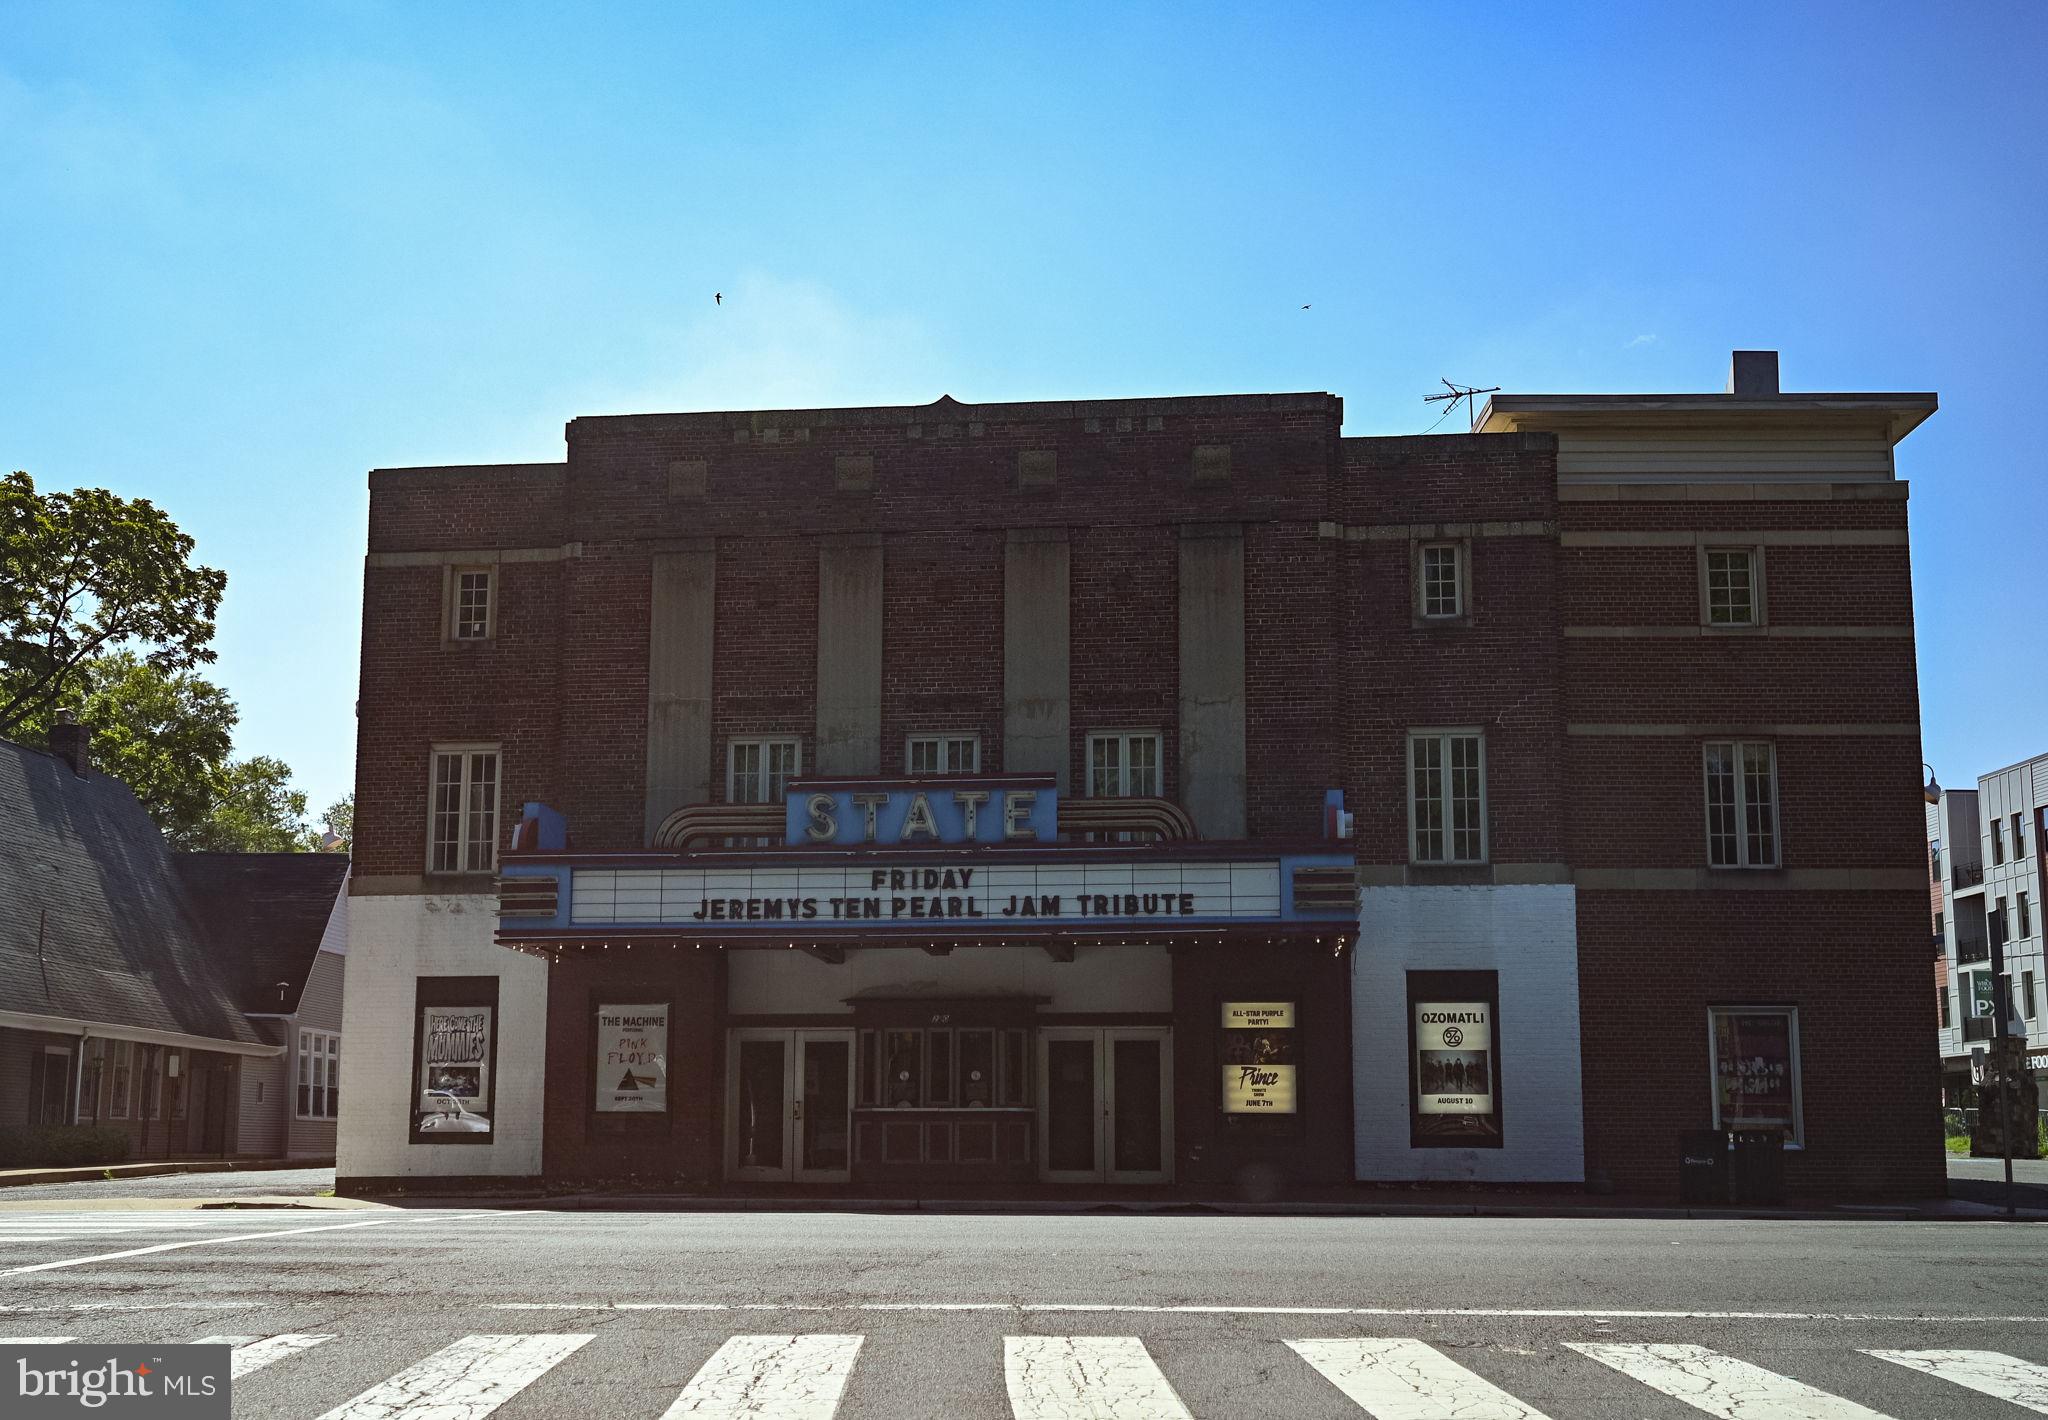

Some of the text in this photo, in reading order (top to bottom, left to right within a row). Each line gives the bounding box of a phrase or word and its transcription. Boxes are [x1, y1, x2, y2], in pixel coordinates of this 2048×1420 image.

[805, 791, 1038, 841] STATE
[872, 868, 974, 890] FRIDAY
[693, 893, 1194, 920] JEREMYS TEN PEARL JAM TRIBUTE
[430, 1014, 450, 1034] HERE
[468, 1014, 484, 1033] THE
[602, 1016, 665, 1026] THE MACHINE
[1421, 1012, 1485, 1024] OZOMATLI
[427, 1031, 485, 1064] MUMMIES
[619, 1038, 648, 1050] PINK
[608, 1051, 657, 1065] FLOYD
[2031, 1055, 2048, 1069] FOO
[1238, 1066, 1279, 1090] Prince
[1245, 1099, 1273, 1107] JUNE 7TH
